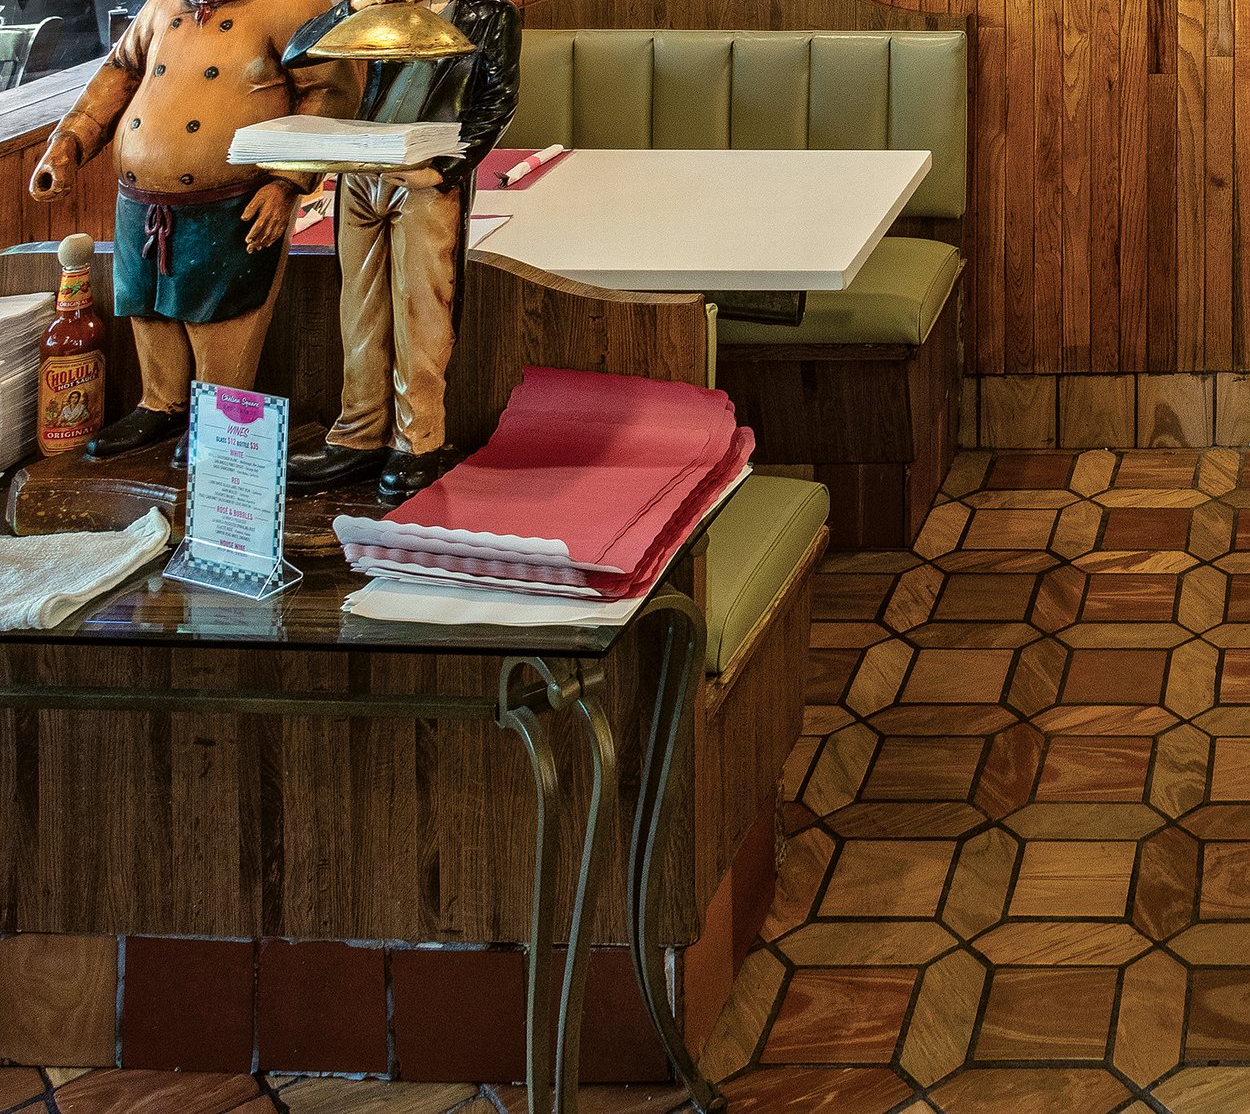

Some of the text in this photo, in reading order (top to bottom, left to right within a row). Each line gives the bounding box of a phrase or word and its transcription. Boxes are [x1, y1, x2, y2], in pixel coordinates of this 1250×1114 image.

[46, 361, 100, 392] CHOLULA
[58, 381, 75, 391] HOT
[47, 426, 95, 439] ORIGINAL
[226, 424, 250, 438] WINES
[231, 476, 240, 485] RED
